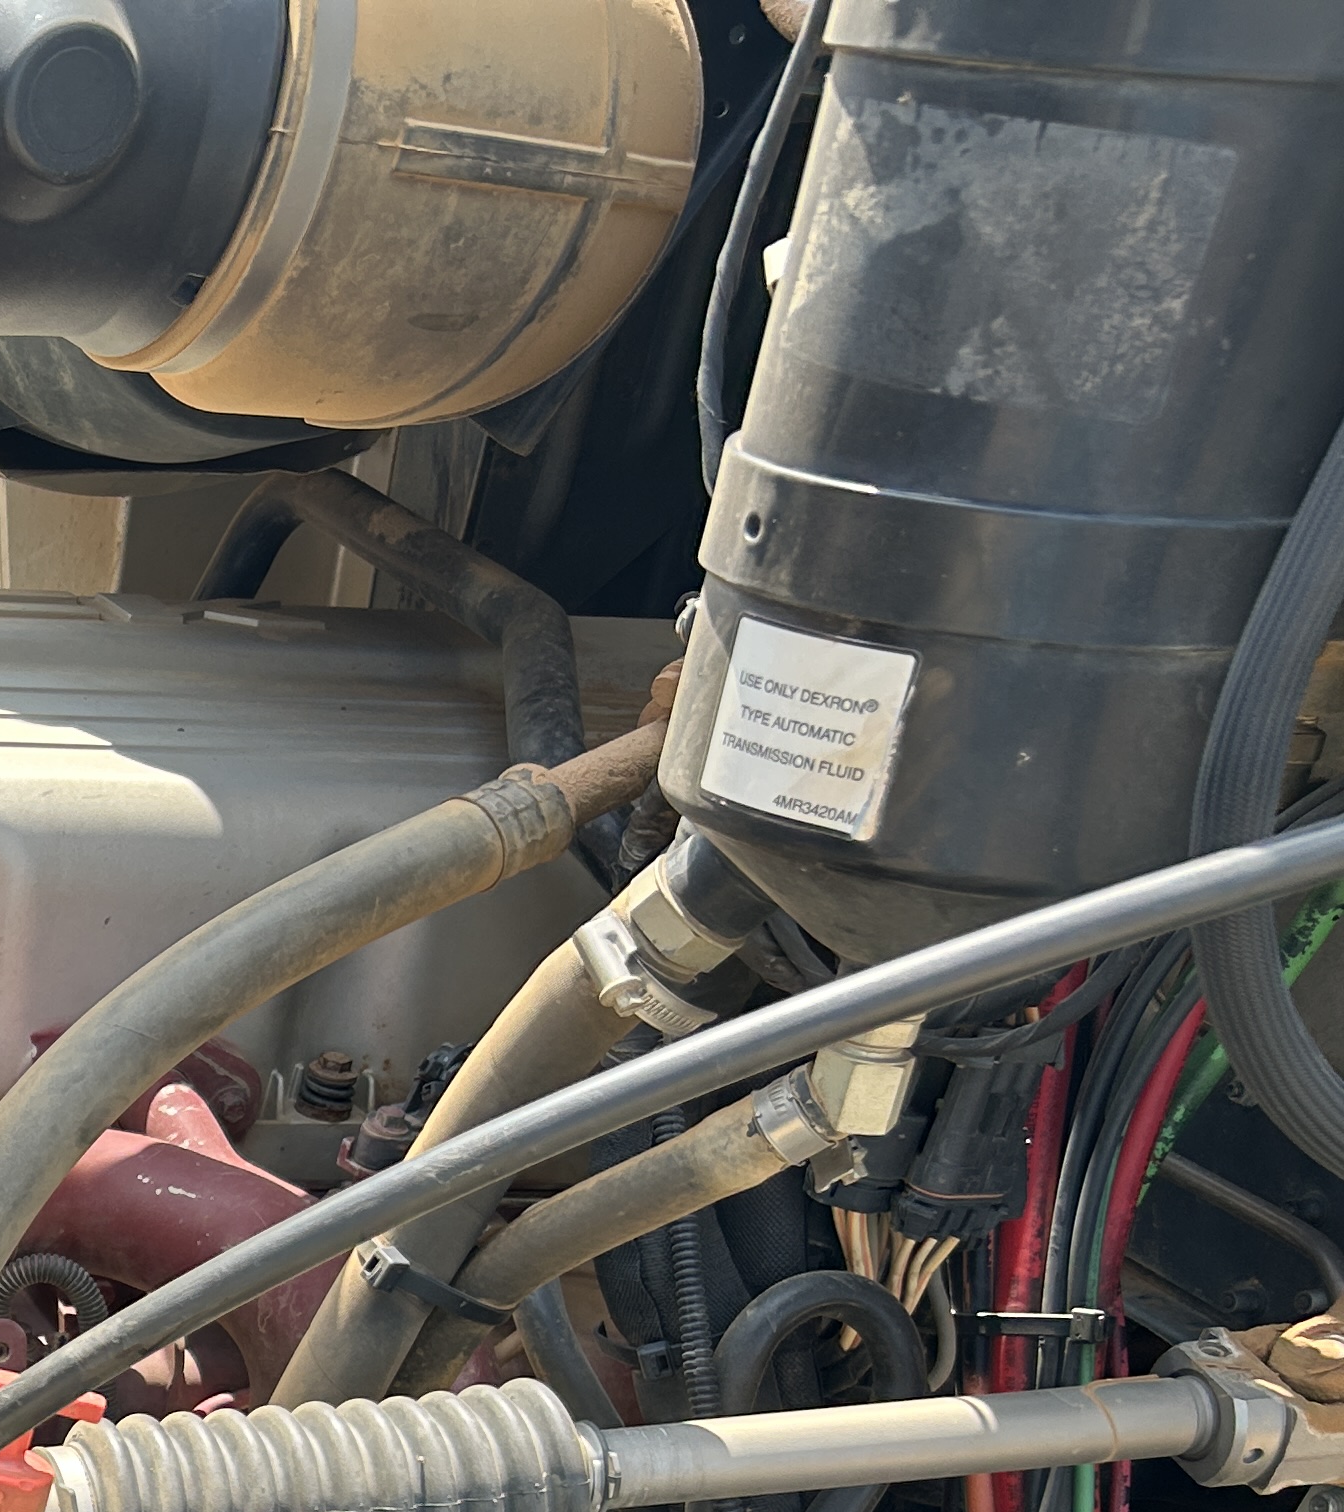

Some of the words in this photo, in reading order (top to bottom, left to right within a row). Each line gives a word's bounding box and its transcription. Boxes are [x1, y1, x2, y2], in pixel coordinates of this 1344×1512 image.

[739, 670, 765, 690] USE
[764, 679, 800, 699] ONLY
[799, 689, 879, 716] DEXRON®
[740, 704, 772, 727] TYPE
[771, 716, 856, 747] AUTOMATIC
[722, 731, 816, 772] TRANSMISSION
[817, 759, 865, 782] FLUID
[772, 794, 859, 825] 4MR3420AM
